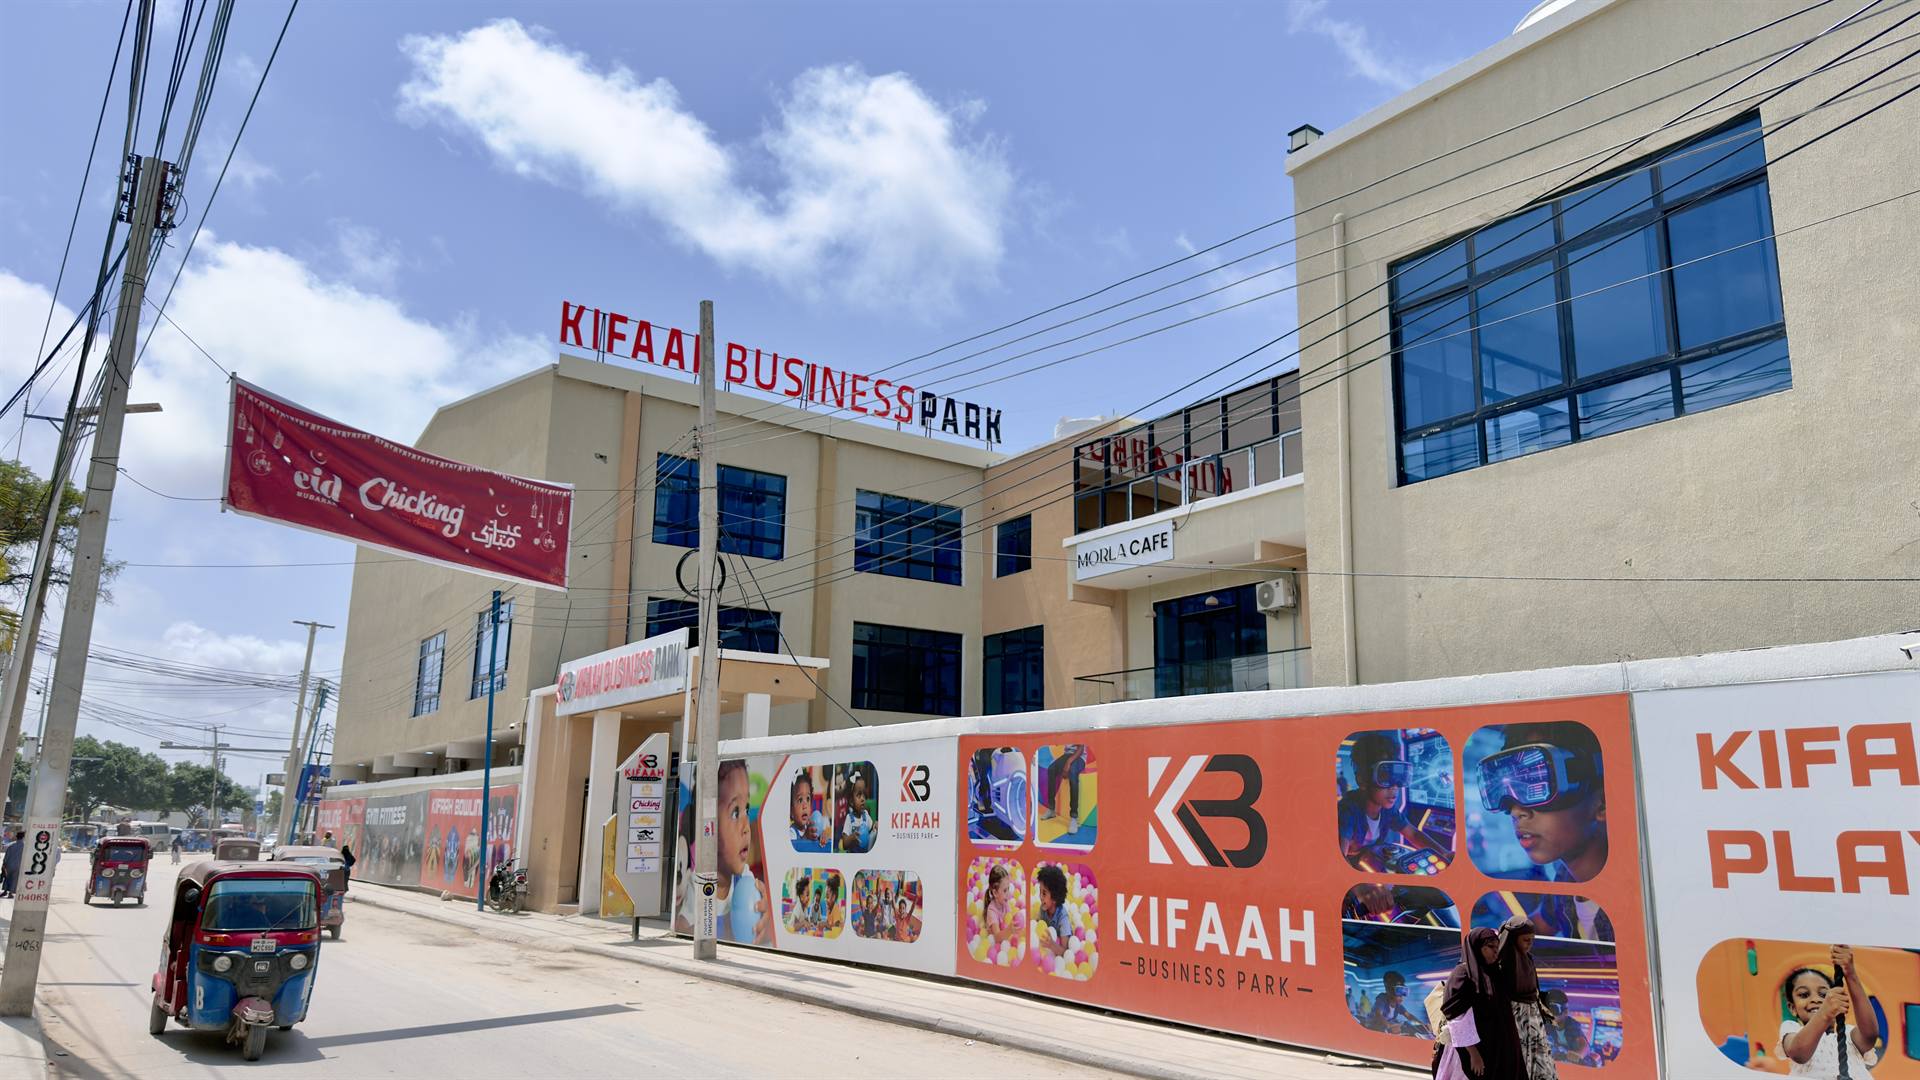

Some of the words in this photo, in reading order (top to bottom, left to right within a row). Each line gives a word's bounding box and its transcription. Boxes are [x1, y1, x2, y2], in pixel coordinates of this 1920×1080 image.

[559, 300, 700, 374] KIFAA
[725, 342, 915, 424] BUSINESS
[920, 390, 1003, 445] PARK
[293, 466, 343, 503] eid
[358, 477, 466, 538] Chicking
[1077, 543, 1127, 569] MORLA
[1129, 531, 1169, 556] CAFE
[604, 649, 655, 692] BUSINESS
[654, 642, 681, 680] PARK
[624, 768, 664, 777] KIFAAH
[454, 799, 484, 816] BOWLIN
[632, 799, 661, 810] Chicking
[891, 811, 940, 829] KIFAAH
[25, 830, 51, 876] beco
[1707, 829, 1920, 896] PLA
[1115, 893, 1317, 967] KIFAAH
[1137, 957, 1226, 989] BUSINESS
[1237, 970, 1289, 998] PARK
